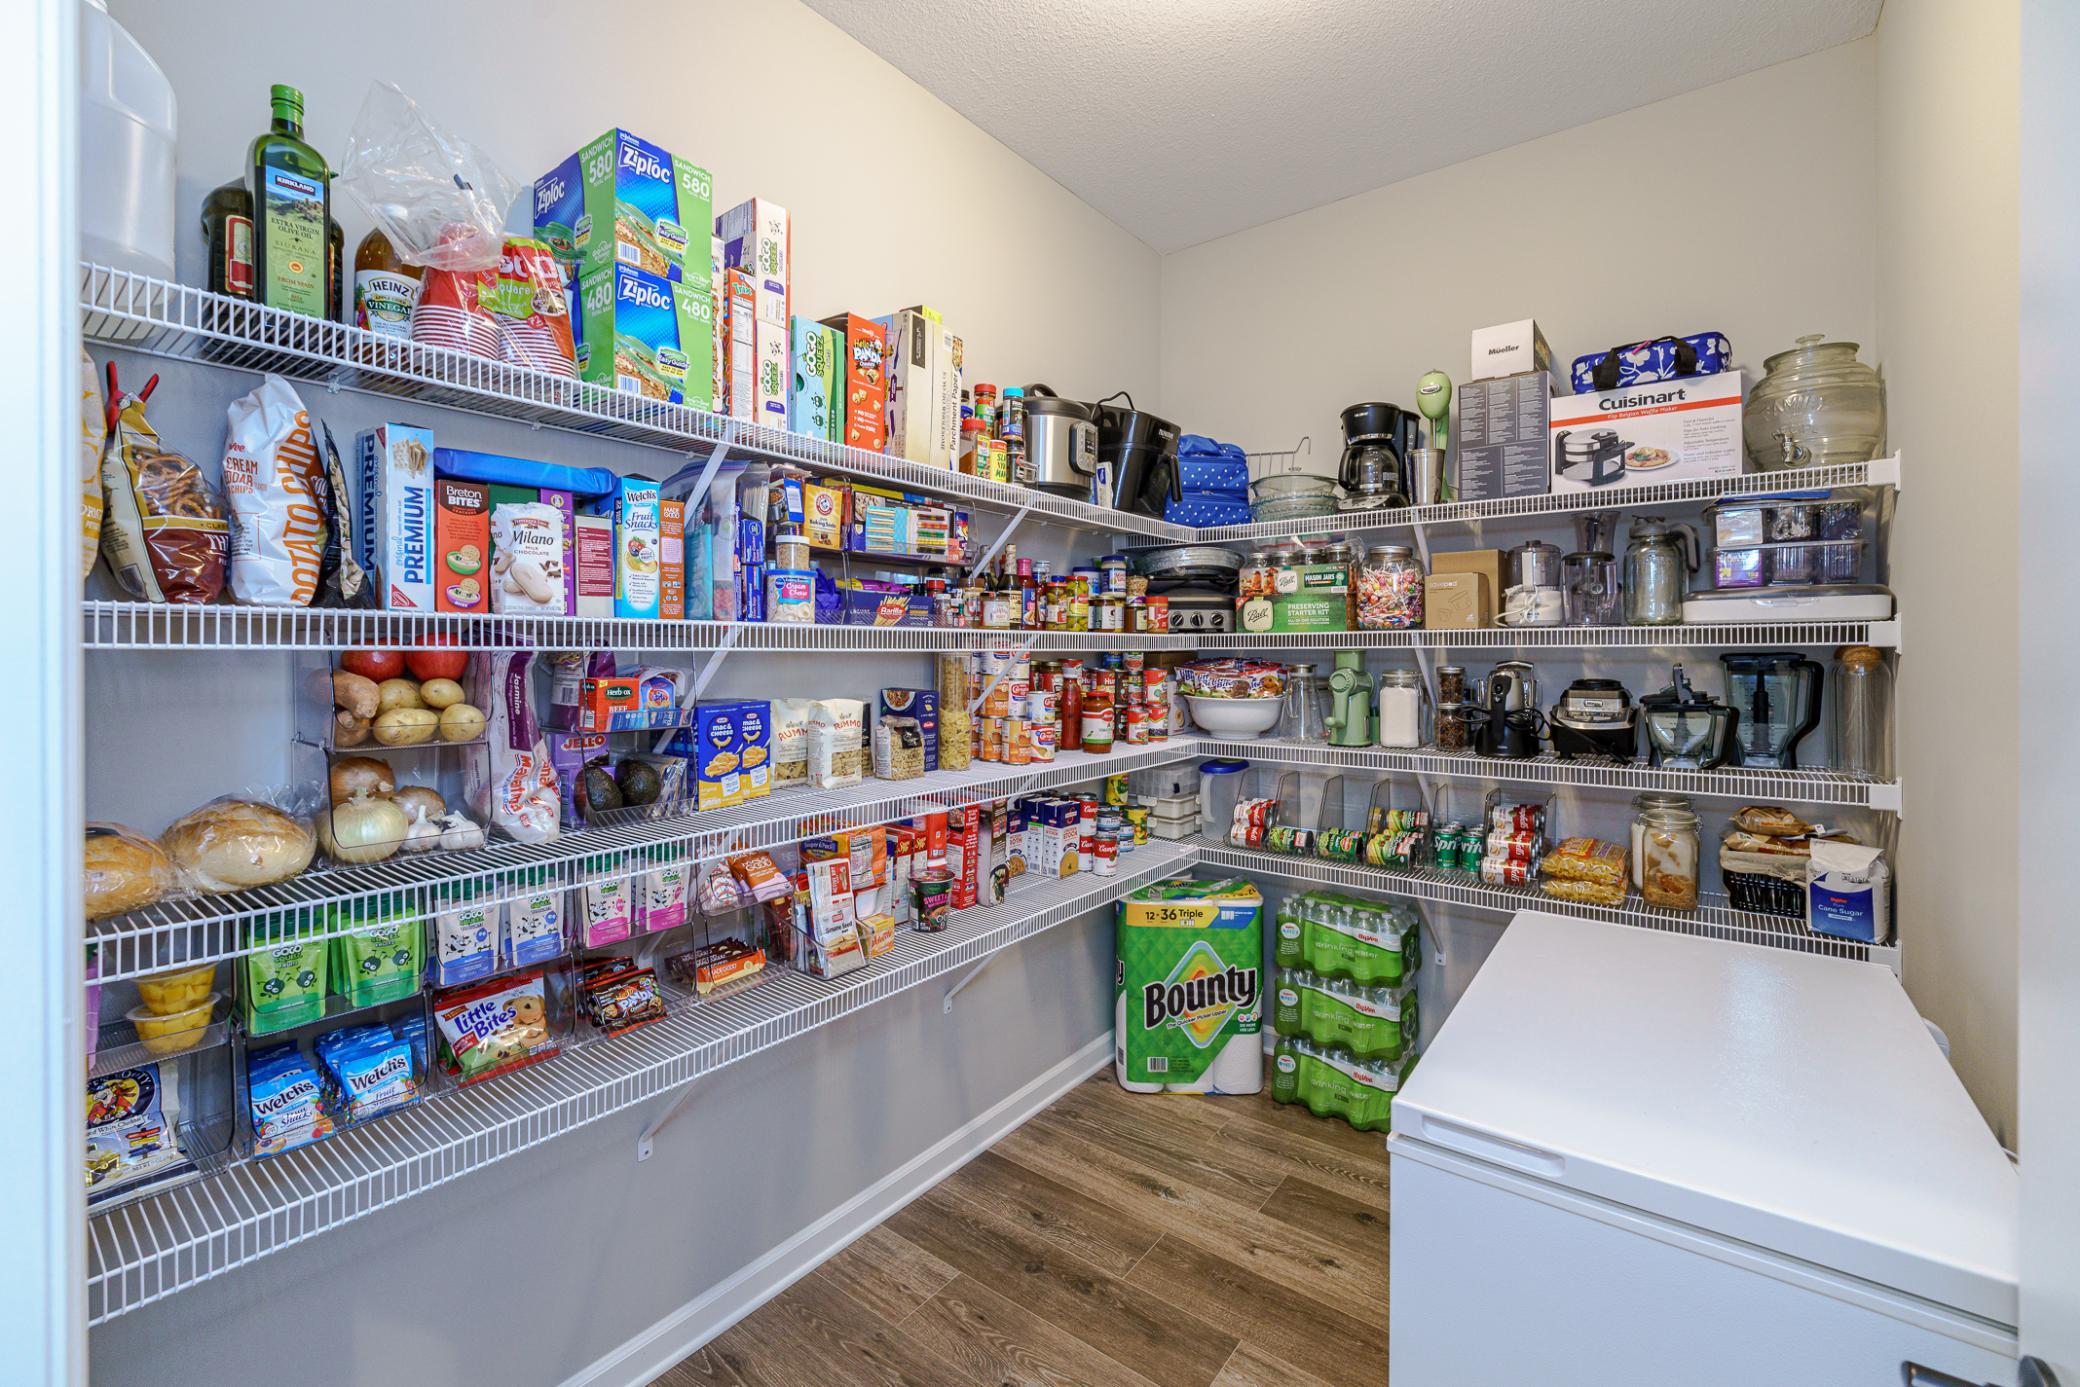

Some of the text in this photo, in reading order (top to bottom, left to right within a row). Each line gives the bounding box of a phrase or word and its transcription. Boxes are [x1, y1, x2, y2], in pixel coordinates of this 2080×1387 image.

[581, 136, 613, 163] SANDWICH
[588, 150, 613, 184] 580
[622, 146, 671, 184] Ziploc
[673, 160, 711, 183] SANDWICH
[276, 176, 316, 193] KIRKLAND
[682, 173, 710, 198] 580
[536, 181, 565, 214] Ziploc
[272, 218, 320, 236] EXTRA VIRGIN
[279, 226, 313, 240] OLIVE OIL
[581, 268, 613, 291] SANDWICH
[372, 281, 409, 297] HEINZ
[586, 282, 612, 312] 480
[623, 279, 671, 310] Ziploc
[673, 286, 710, 304] SANDWICH
[732, 282, 753, 298] Trix
[682, 299, 710, 320] 480
[854, 340, 870, 349] Hello
[853, 347, 883, 364] PANDA
[1599, 388, 1686, 411] Cuisinart
[1619, 411, 1639, 419] Belgian
[950, 400, 959, 451] Parchment
[446, 485, 482, 499] Breton
[626, 489, 656, 503] Welch's
[365, 434, 375, 571] PREMIUM
[448, 497, 480, 508] BITES
[624, 519, 658, 530] Snacks
[631, 512, 654, 521] Fruit
[809, 518, 836, 529] Baking Soda
[404, 486, 424, 584] PREMIUM
[512, 530, 554, 546] Milano
[1279, 575, 1295, 588] Ball
[1305, 573, 1322, 581] MASON
[785, 582, 806, 590] Cream
[880, 607, 902, 616] Barilla
[1287, 602, 1329, 610] PRESERVING
[1247, 608, 1268, 624] Ball
[513, 673, 521, 716] Jasmine
[508, 754, 532, 813] Mahatma
[1083, 805, 1098, 813] Camp
[1063, 830, 1077, 840] STOCK
[1098, 844, 1117, 853] Camp
[459, 910, 484, 921] GOGO
[1145, 908, 1203, 921] 12 36 Triple
[1818, 904, 1863, 916] Cane Sugar
[369, 924, 399, 937] GOGO
[841, 921, 853, 929] Seed
[272, 944, 303, 958] GOGO
[1315, 941, 1378, 959] drinking water
[617, 989, 653, 1012] PANDA
[1143, 965, 1257, 1030] Bounty
[453, 1000, 496, 1035] Little
[474, 1006, 517, 1039] Bites
[1177, 1017, 1196, 1027] Quicker
[1197, 1013, 1211, 1022] Picker
[1212, 1009, 1226, 1018] Upper
[1313, 1010, 1376, 1029] drinking water
[350, 1057, 407, 1091] Welch's
[375, 1086, 396, 1100] Fruit
[1311, 1078, 1347, 1095] drinking
[255, 1080, 315, 1116] Welch's
[280, 1110, 313, 1129] Snacks
